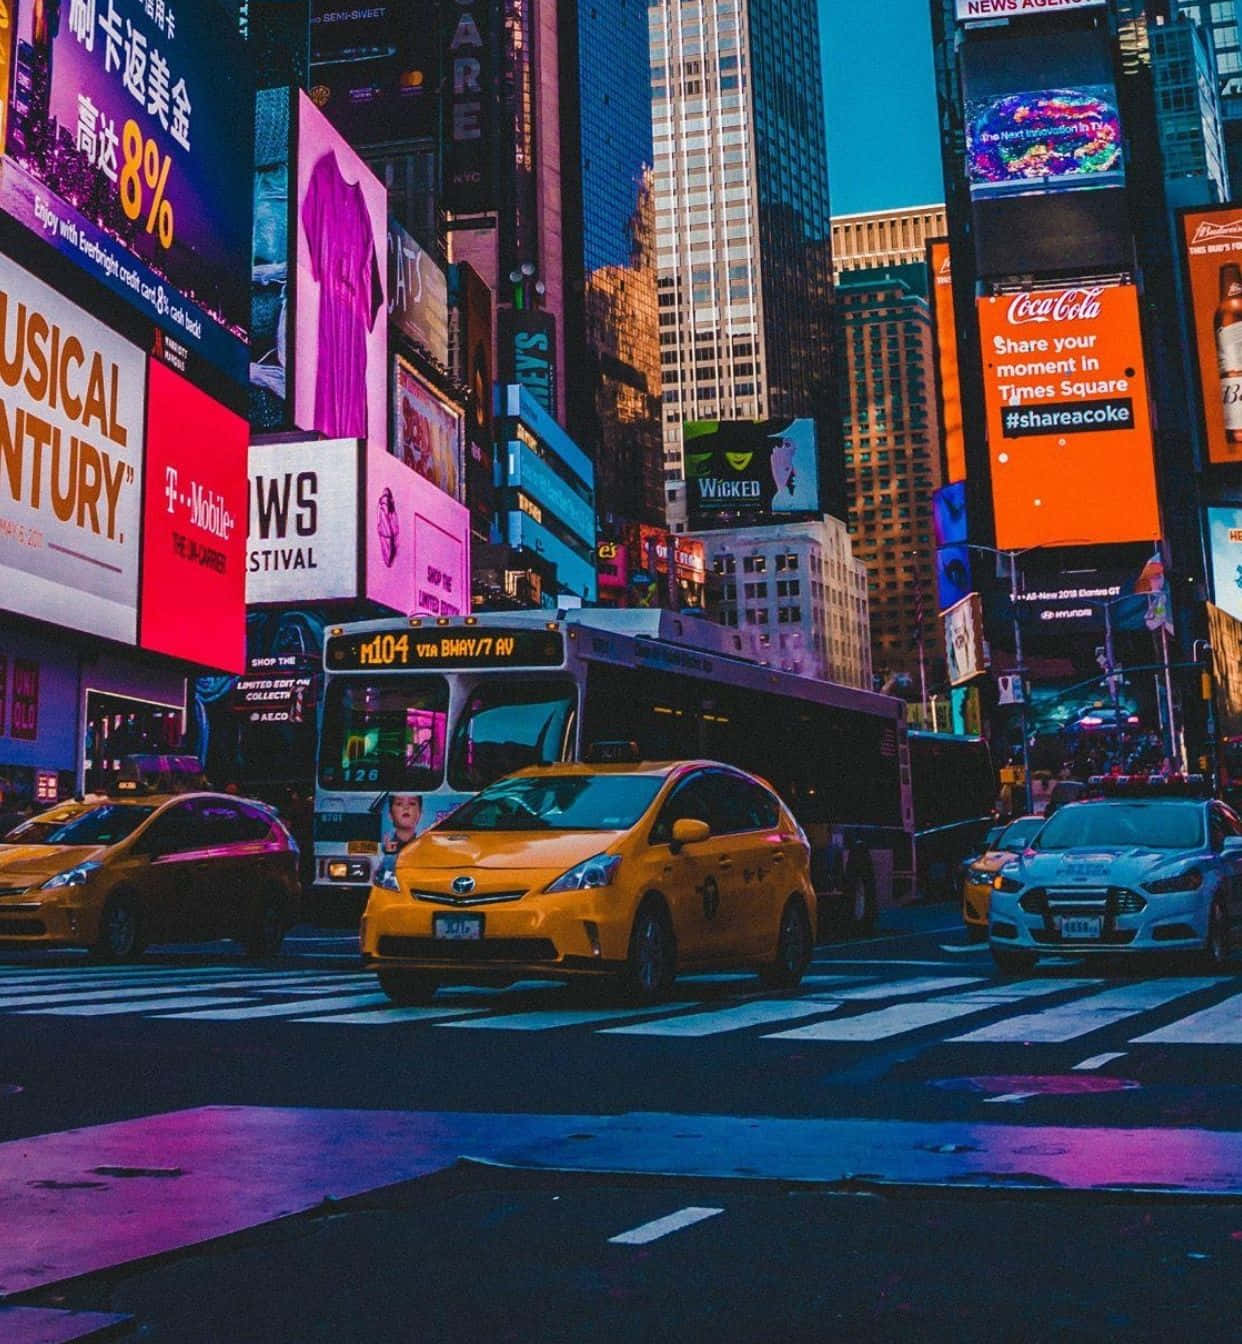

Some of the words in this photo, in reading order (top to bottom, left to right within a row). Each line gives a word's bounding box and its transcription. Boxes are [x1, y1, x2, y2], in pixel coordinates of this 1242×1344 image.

[453, 171, 481, 184] NYC
[34, 195, 58, 235] Enjoy
[59, 220, 78, 246] with
[119, 267, 140, 293] credit
[140, 280, 156, 304] card
[1007, 287, 1104, 325] Coca-Cola
[994, 336, 1048, 355] Share
[1053, 334, 1097, 353] your
[997, 359, 1076, 377] moment
[1081, 357, 1099, 371] in
[998, 384, 1055, 401] Times
[1060, 378, 1129, 398] Square
[1005, 405, 1130, 430] #shareacoke
[247, 547, 318, 573] STIVAL
[1108, 586, 1120, 595] GT
[360, 634, 409, 665] M104
[416, 645, 438, 658] VIA
[440, 637, 493, 657] BWAY/7
[495, 637, 515, 656] AV
[251, 657, 277, 667] SHOP
[278, 656, 296, 665] THE
[237, 680, 272, 690] LIMITED
[273, 679, 311, 689] EDITON
[343, 767, 380, 782] 126
